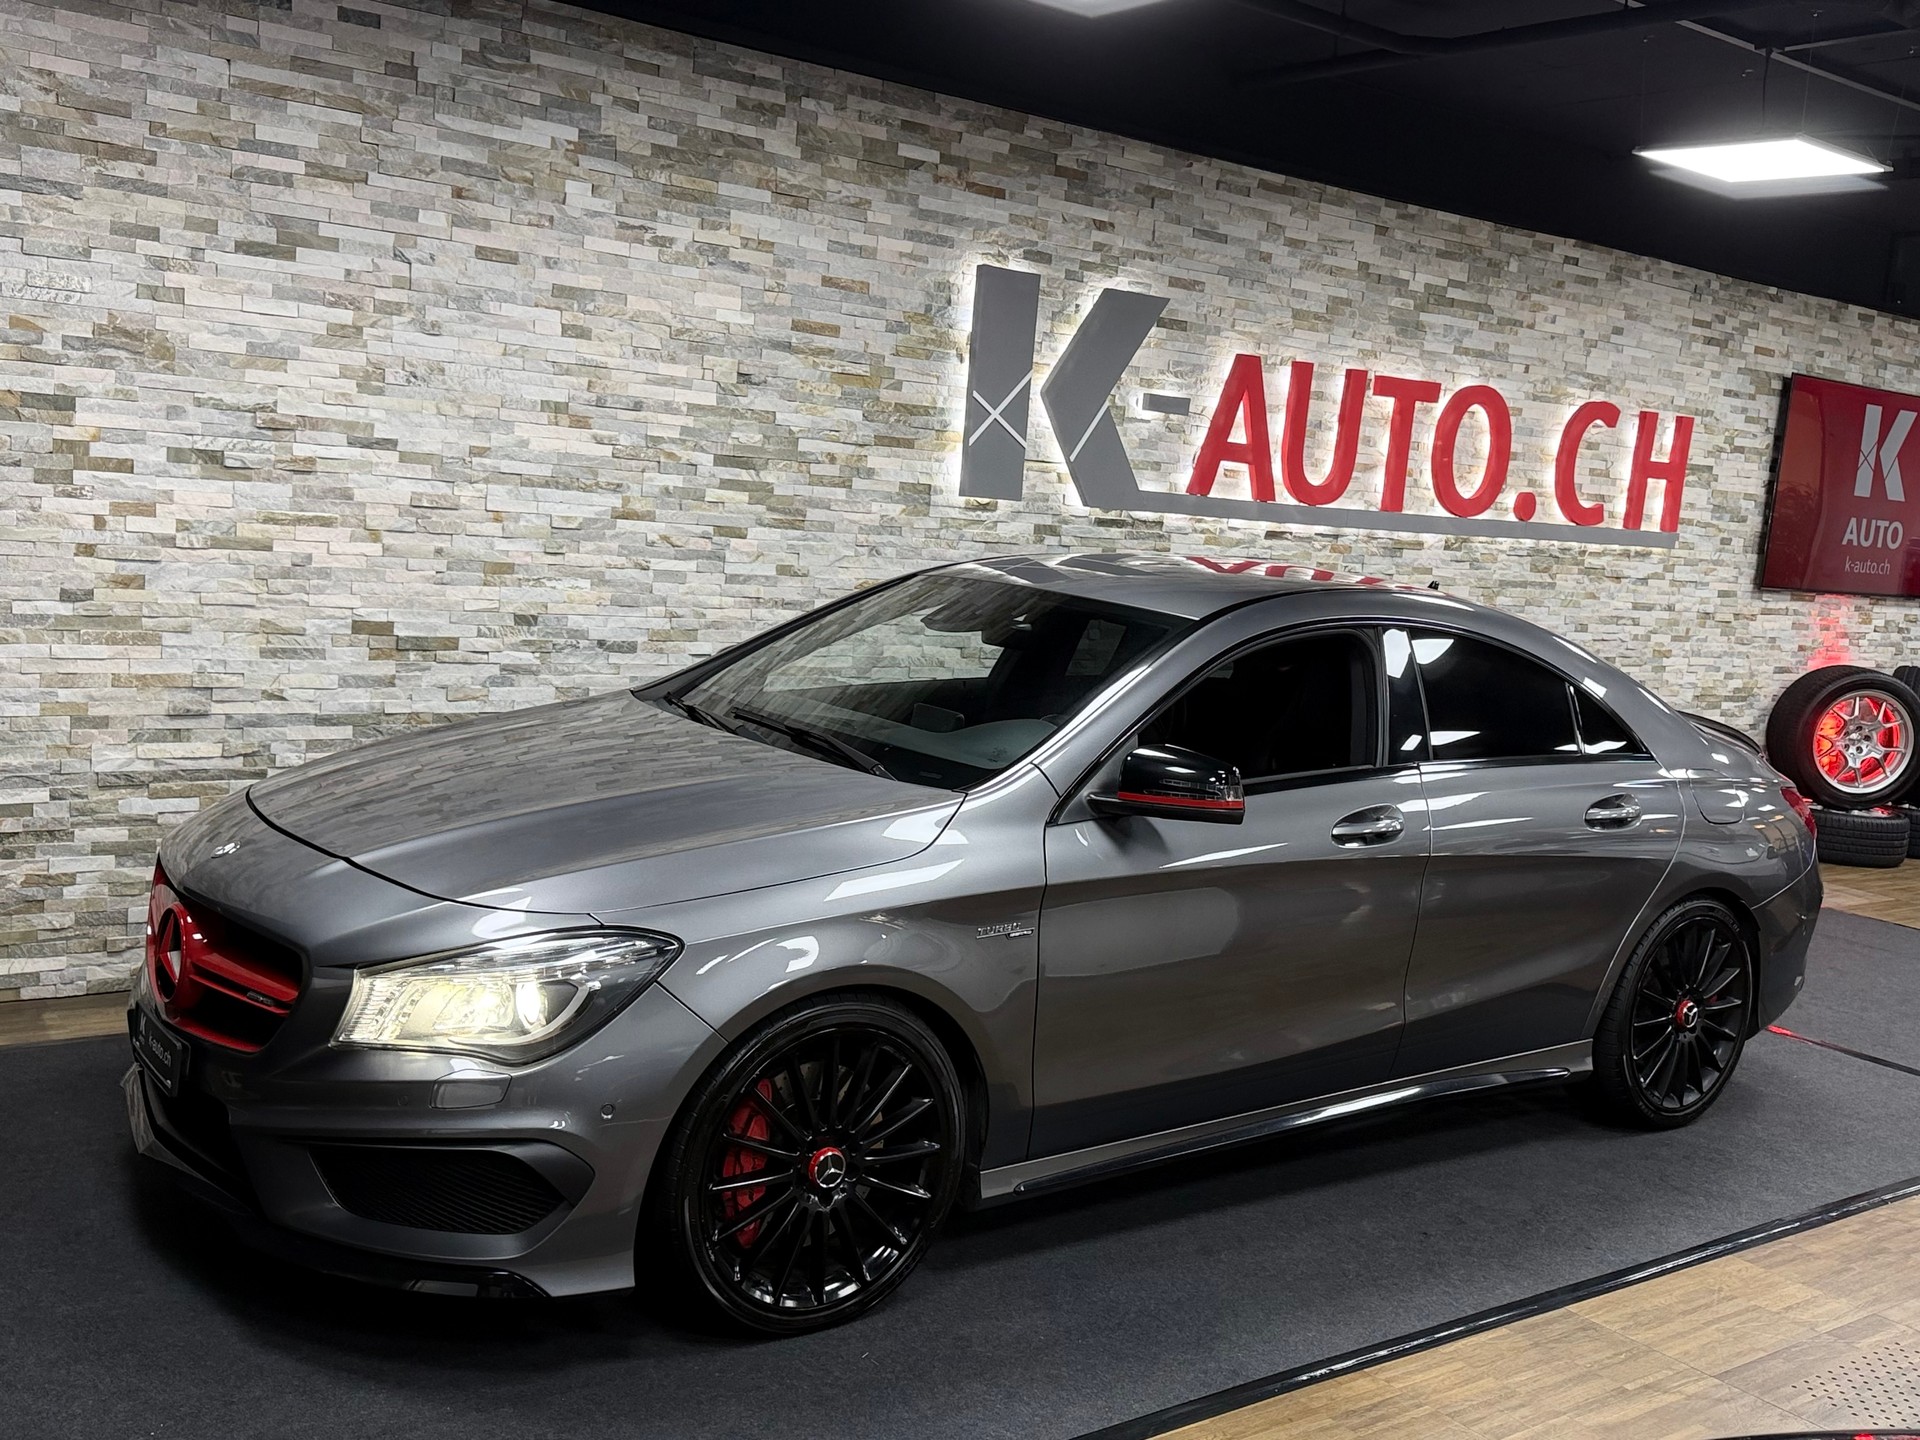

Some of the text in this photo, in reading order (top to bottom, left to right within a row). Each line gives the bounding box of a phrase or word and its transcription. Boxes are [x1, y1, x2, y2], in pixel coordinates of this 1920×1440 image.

[959, 264, 1695, 533] K-AUTO.CH
[1854, 403, 1918, 502] K
[1842, 517, 1904, 550] AUTO
[1845, 558, 1891, 575] k-auto.ch
